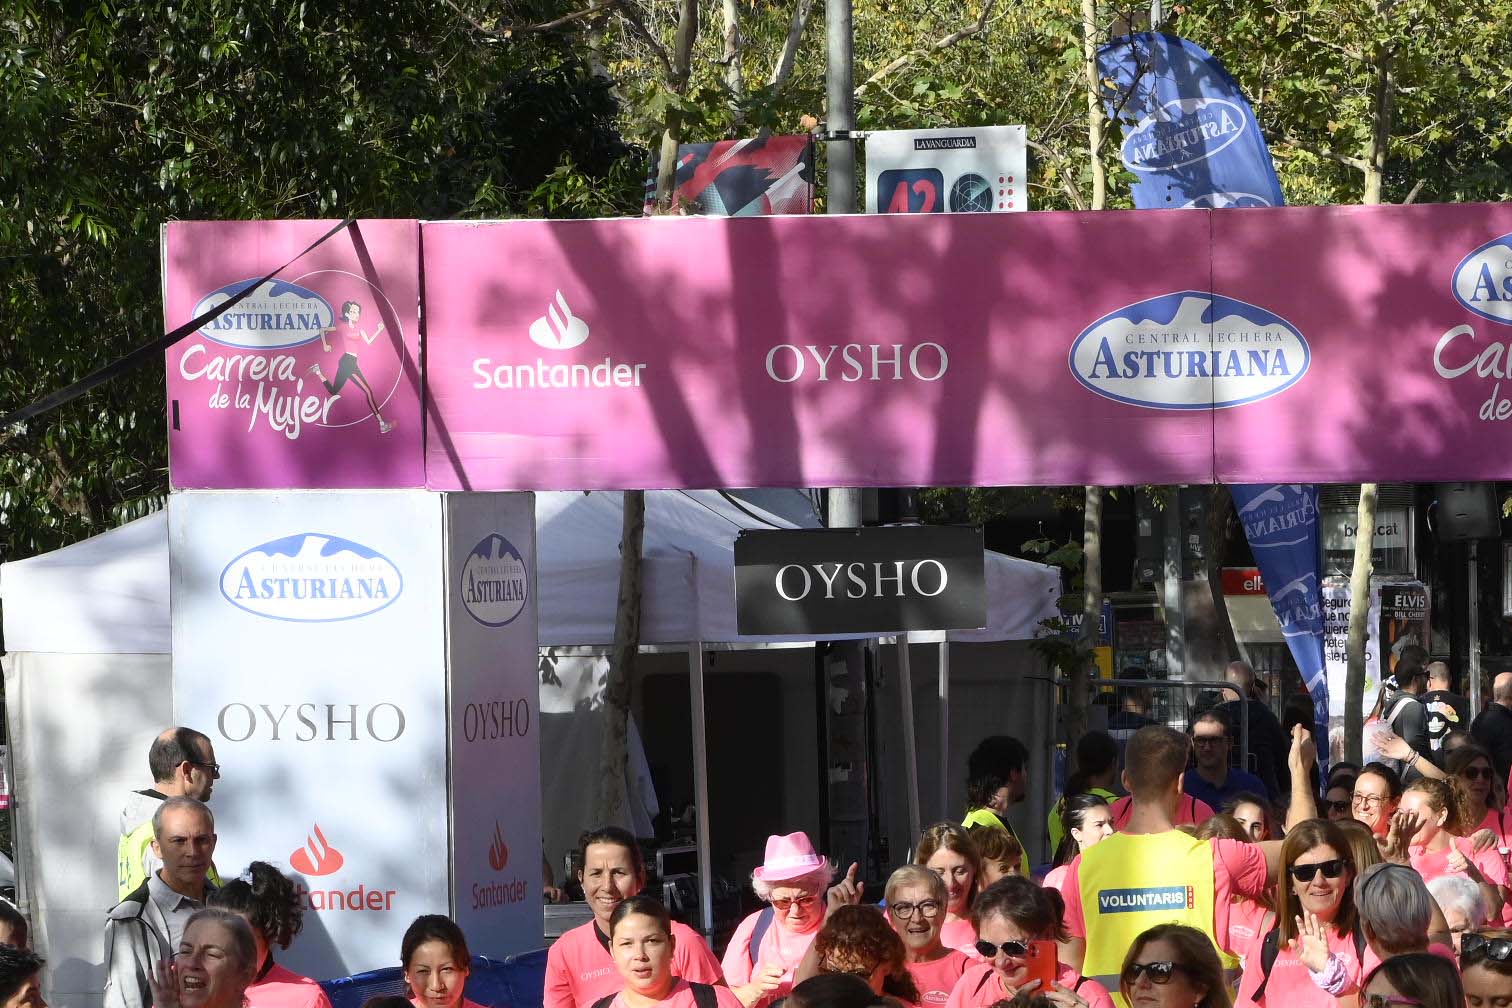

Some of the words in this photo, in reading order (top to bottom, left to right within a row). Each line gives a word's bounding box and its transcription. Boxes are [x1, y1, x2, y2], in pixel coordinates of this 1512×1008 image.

[1125, 333, 1200, 345] CENTRAL
[1207, 331, 1284, 344] LECHERA
[179, 344, 297, 382] Carrera
[472, 355, 648, 390] Santander
[764, 342, 950, 383] OYSHO
[1088, 336, 1292, 380] ASTURIANA
[208, 383, 229, 410] de
[234, 381, 252, 410] la
[246, 377, 342, 440] Mujer
[234, 566, 391, 600] ASTURIANA
[466, 570, 525, 604] ASTURIANA
[775, 559, 949, 603] OYSHO
[1394, 595, 1425, 608] ELVIS
[216, 702, 406, 743] OYSHO
[463, 698, 531, 744] OYSHO
[297, 884, 397, 912] tander
[472, 878, 529, 910] Santander
[1100, 891, 1185, 908] VOLUNTARIS
